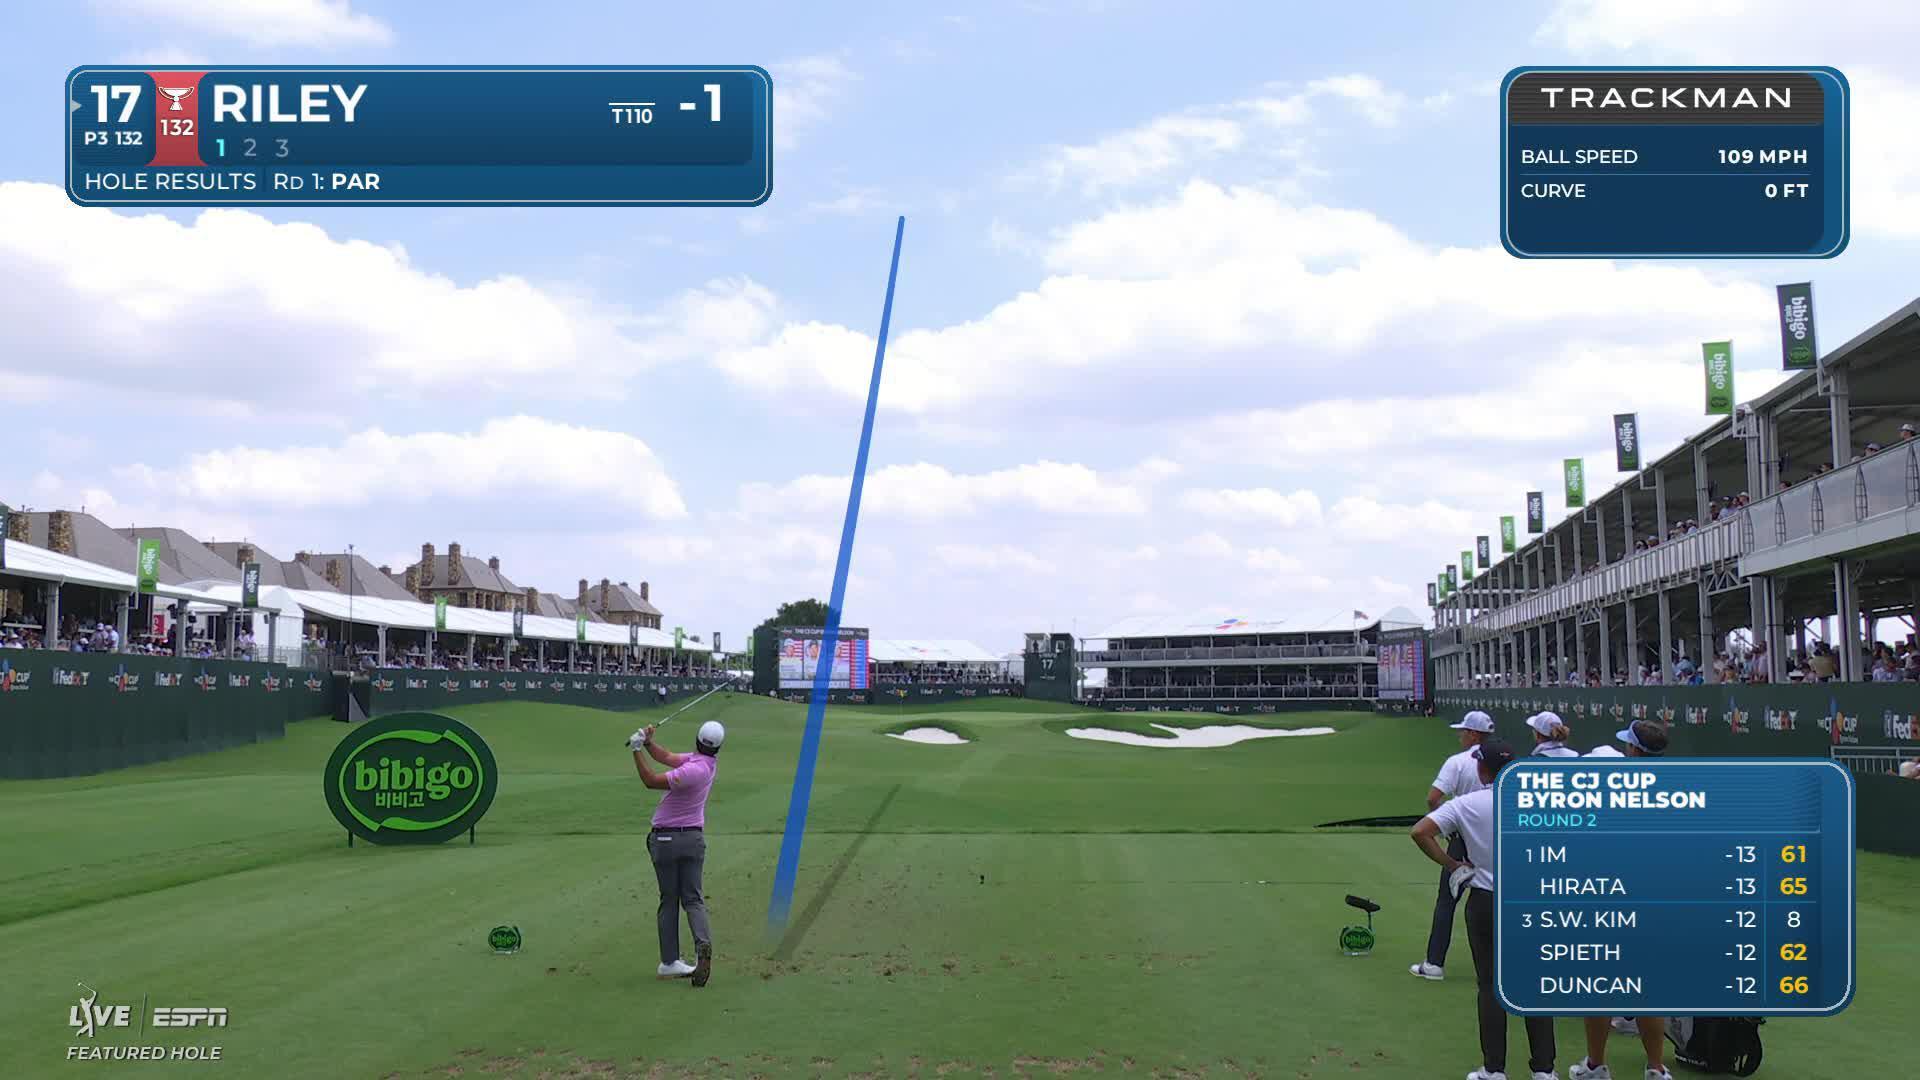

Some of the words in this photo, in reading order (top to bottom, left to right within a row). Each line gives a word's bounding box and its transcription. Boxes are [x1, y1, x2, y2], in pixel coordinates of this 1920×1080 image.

[1789, 296, 1808, 340] bibigo
[355, 757, 473, 800] bibigo
[375, 792, 425, 808] 비비고
